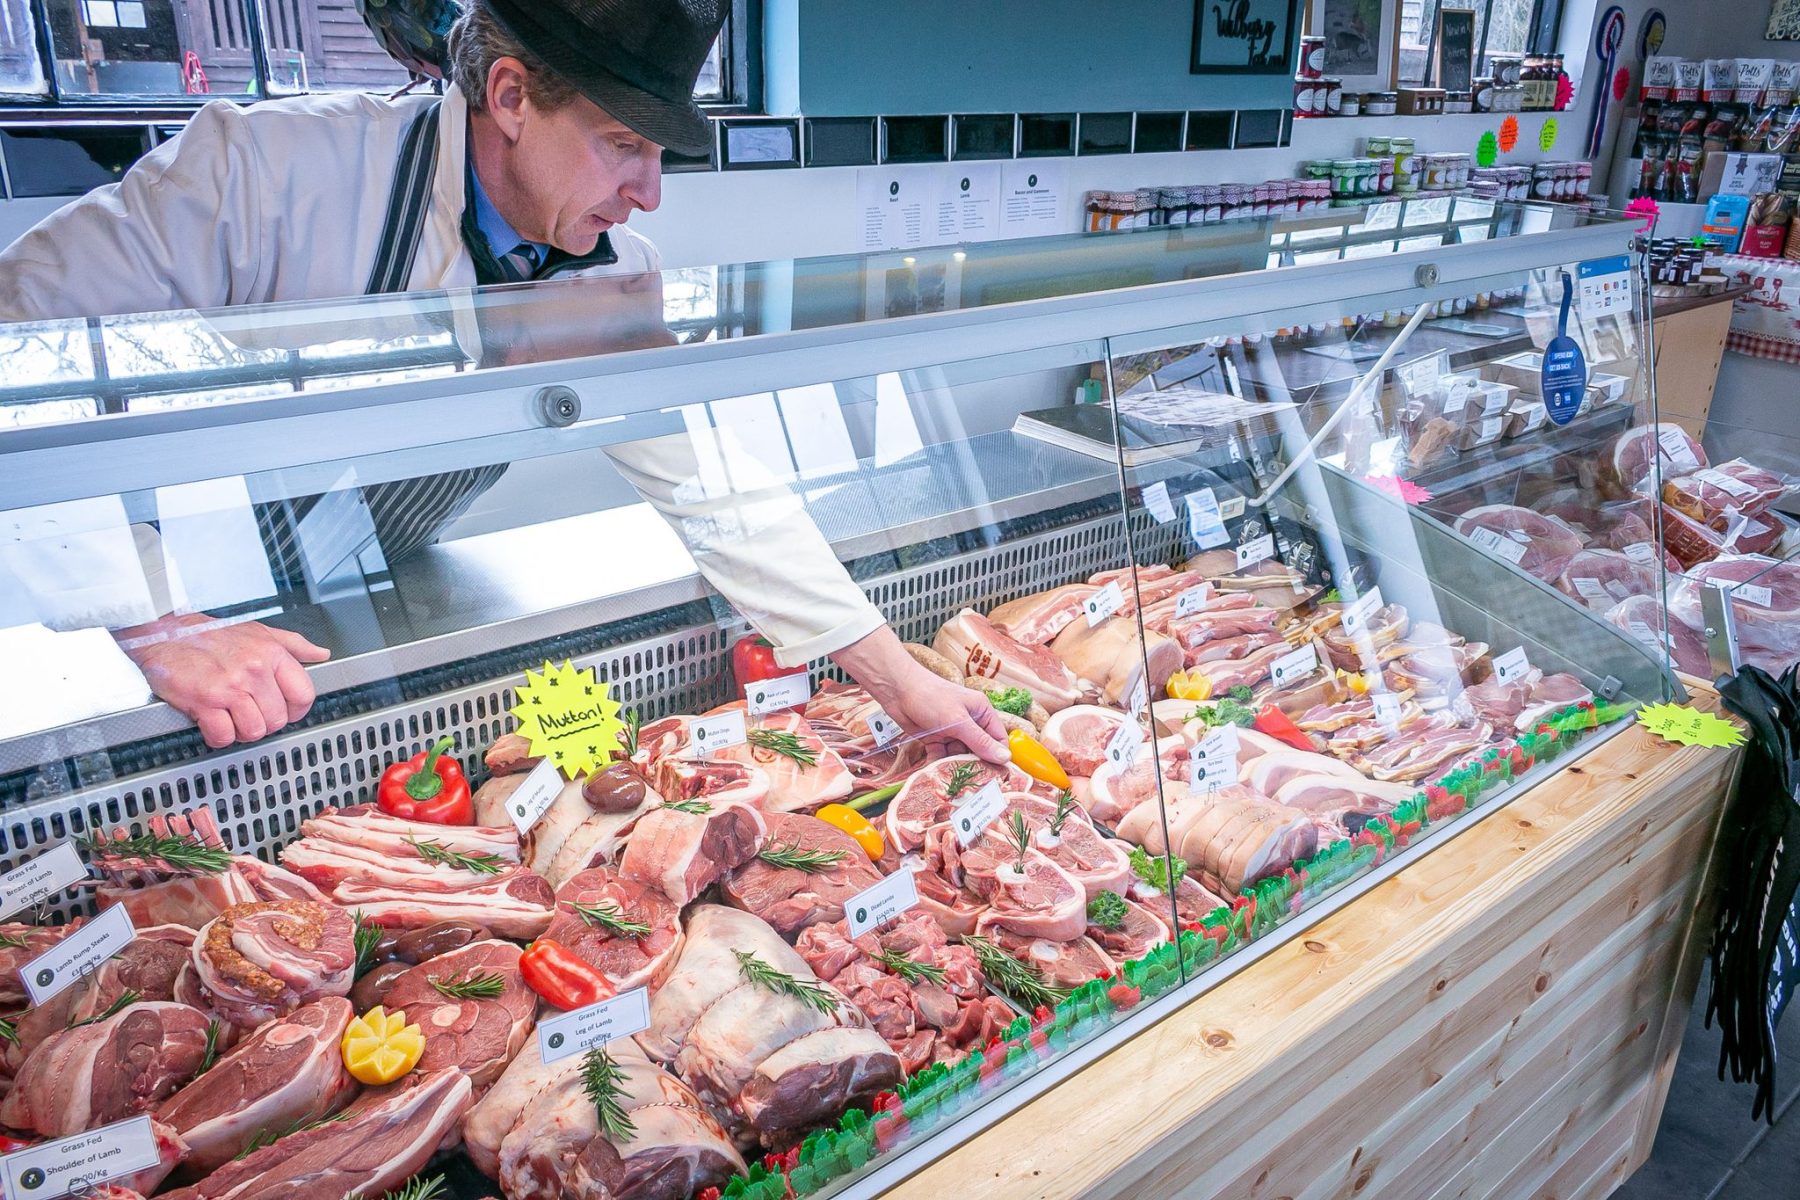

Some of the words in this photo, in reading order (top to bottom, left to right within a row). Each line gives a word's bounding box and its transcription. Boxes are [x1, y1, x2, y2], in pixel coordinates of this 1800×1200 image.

[537, 703, 606, 735] Mutton!
[7, 870, 25, 882] Grass
[25, 863, 38, 874] Fed
[6, 883, 27, 897] Breast
[27, 877, 35, 887] of
[34, 869, 53, 882] Lamb
[870, 901, 882, 911] Diced
[55, 957, 73, 973] Lamb
[73, 946, 91, 961] Rump
[90, 932, 110, 948] Steaks
[578, 1011, 596, 1021] Grass
[596, 1006, 608, 1015] Fed
[575, 1028, 587, 1036] Leg
[587, 1023, 595, 1031] of
[595, 1018, 613, 1029] Lamb
[61, 1141, 85, 1153] Grass
[86, 1135, 103, 1146] Fed
[46, 1158, 85, 1176] Shoulder
[87, 1153, 96, 1163] of
[99, 1147, 121, 1160] Lamb
